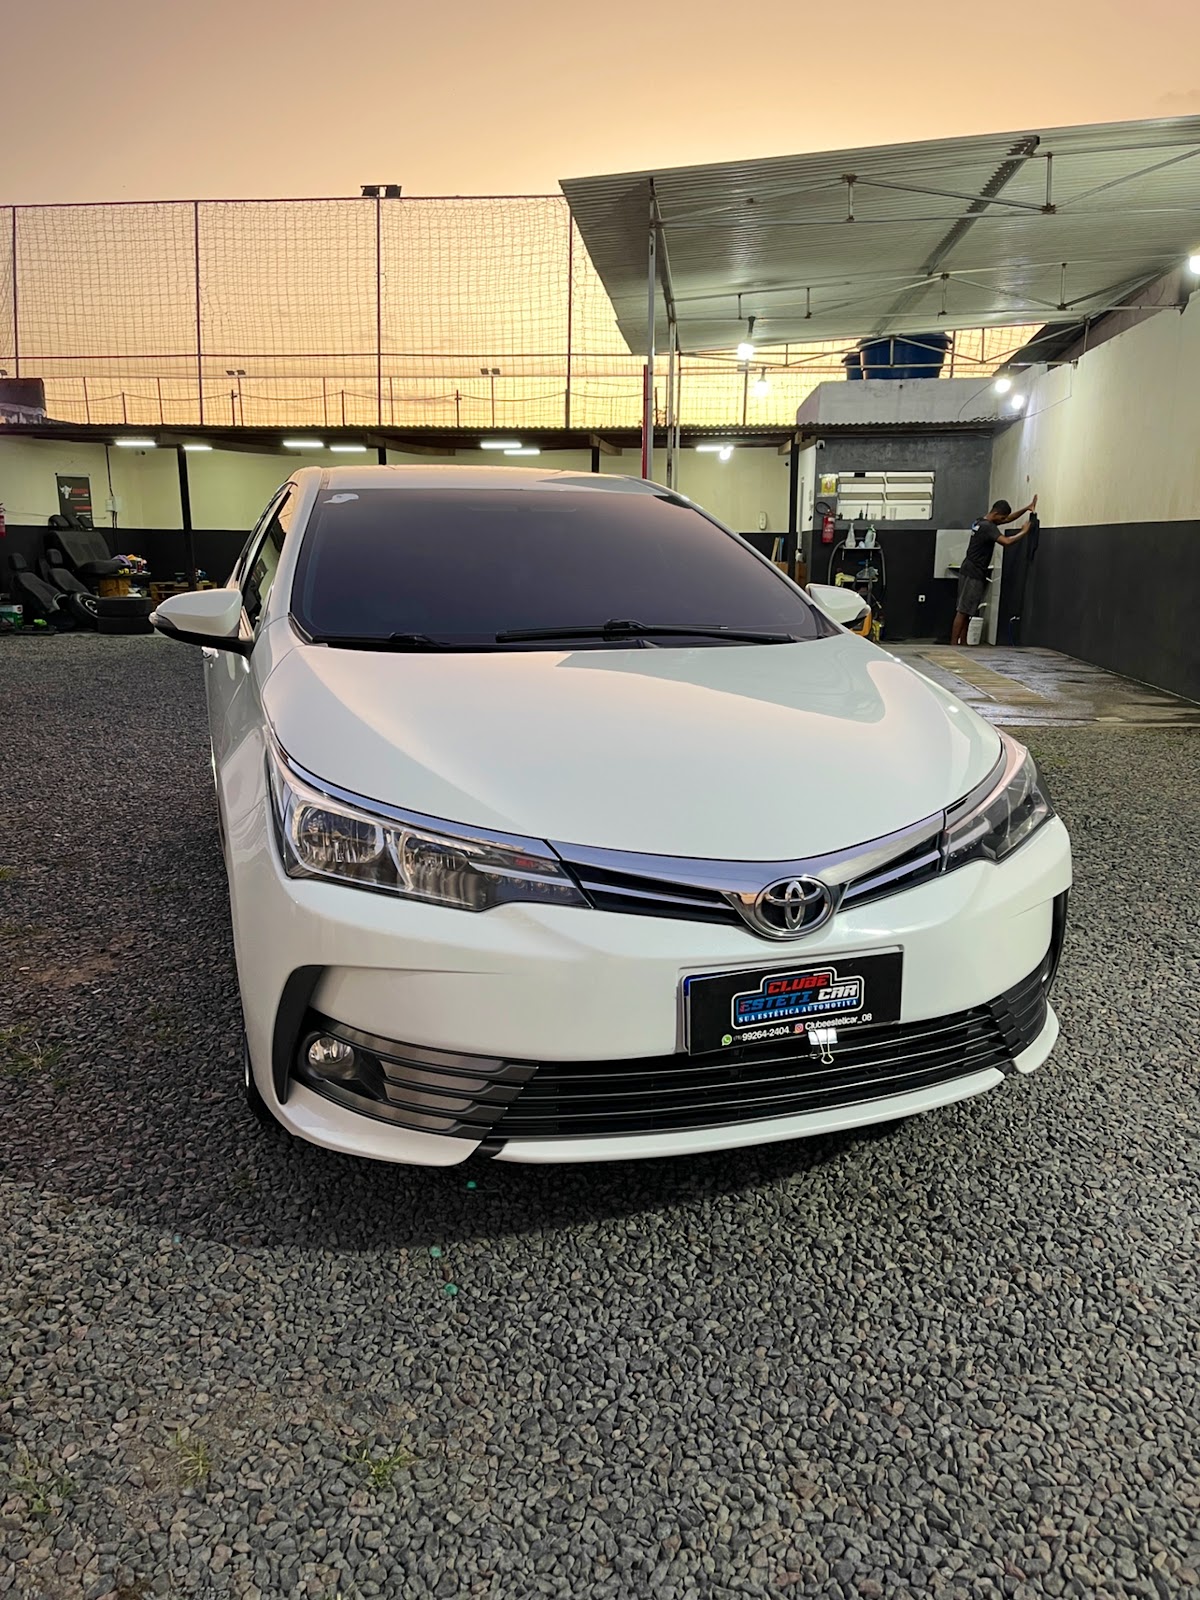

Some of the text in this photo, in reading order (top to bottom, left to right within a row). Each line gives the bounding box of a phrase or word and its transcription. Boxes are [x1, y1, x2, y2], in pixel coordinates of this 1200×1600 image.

[768, 974, 829, 994] CLUBE
[818, 984, 857, 1000] CAR
[738, 999, 857, 1023] SUA ESTÉTICA AUTOMOTIVA
[742, 1026, 789, 1041] 99264-2404
